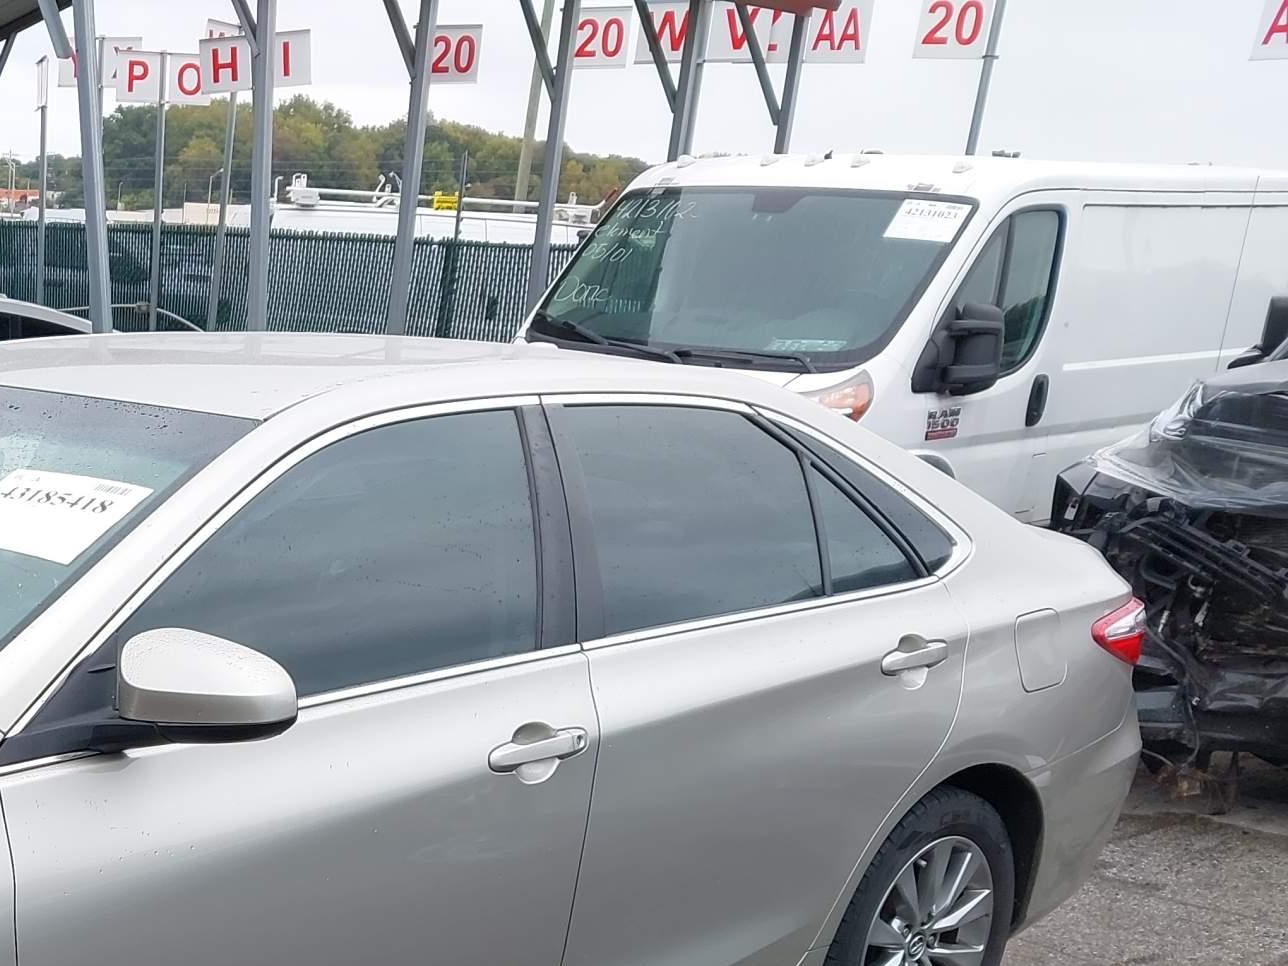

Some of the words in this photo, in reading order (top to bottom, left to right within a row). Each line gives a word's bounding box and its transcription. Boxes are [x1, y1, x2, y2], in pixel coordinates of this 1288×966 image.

[574, 17, 625, 58] 20
[812, 7, 861, 51] AA
[920, 0, 984, 45] 20
[212, 46, 238, 84] H
[431, 35, 476, 74] 20
[127, 60, 149, 93] P
[177, 62, 202, 96] O
[926, 417, 960, 430] 1500
[0, 486, 114, 514] 43185418
